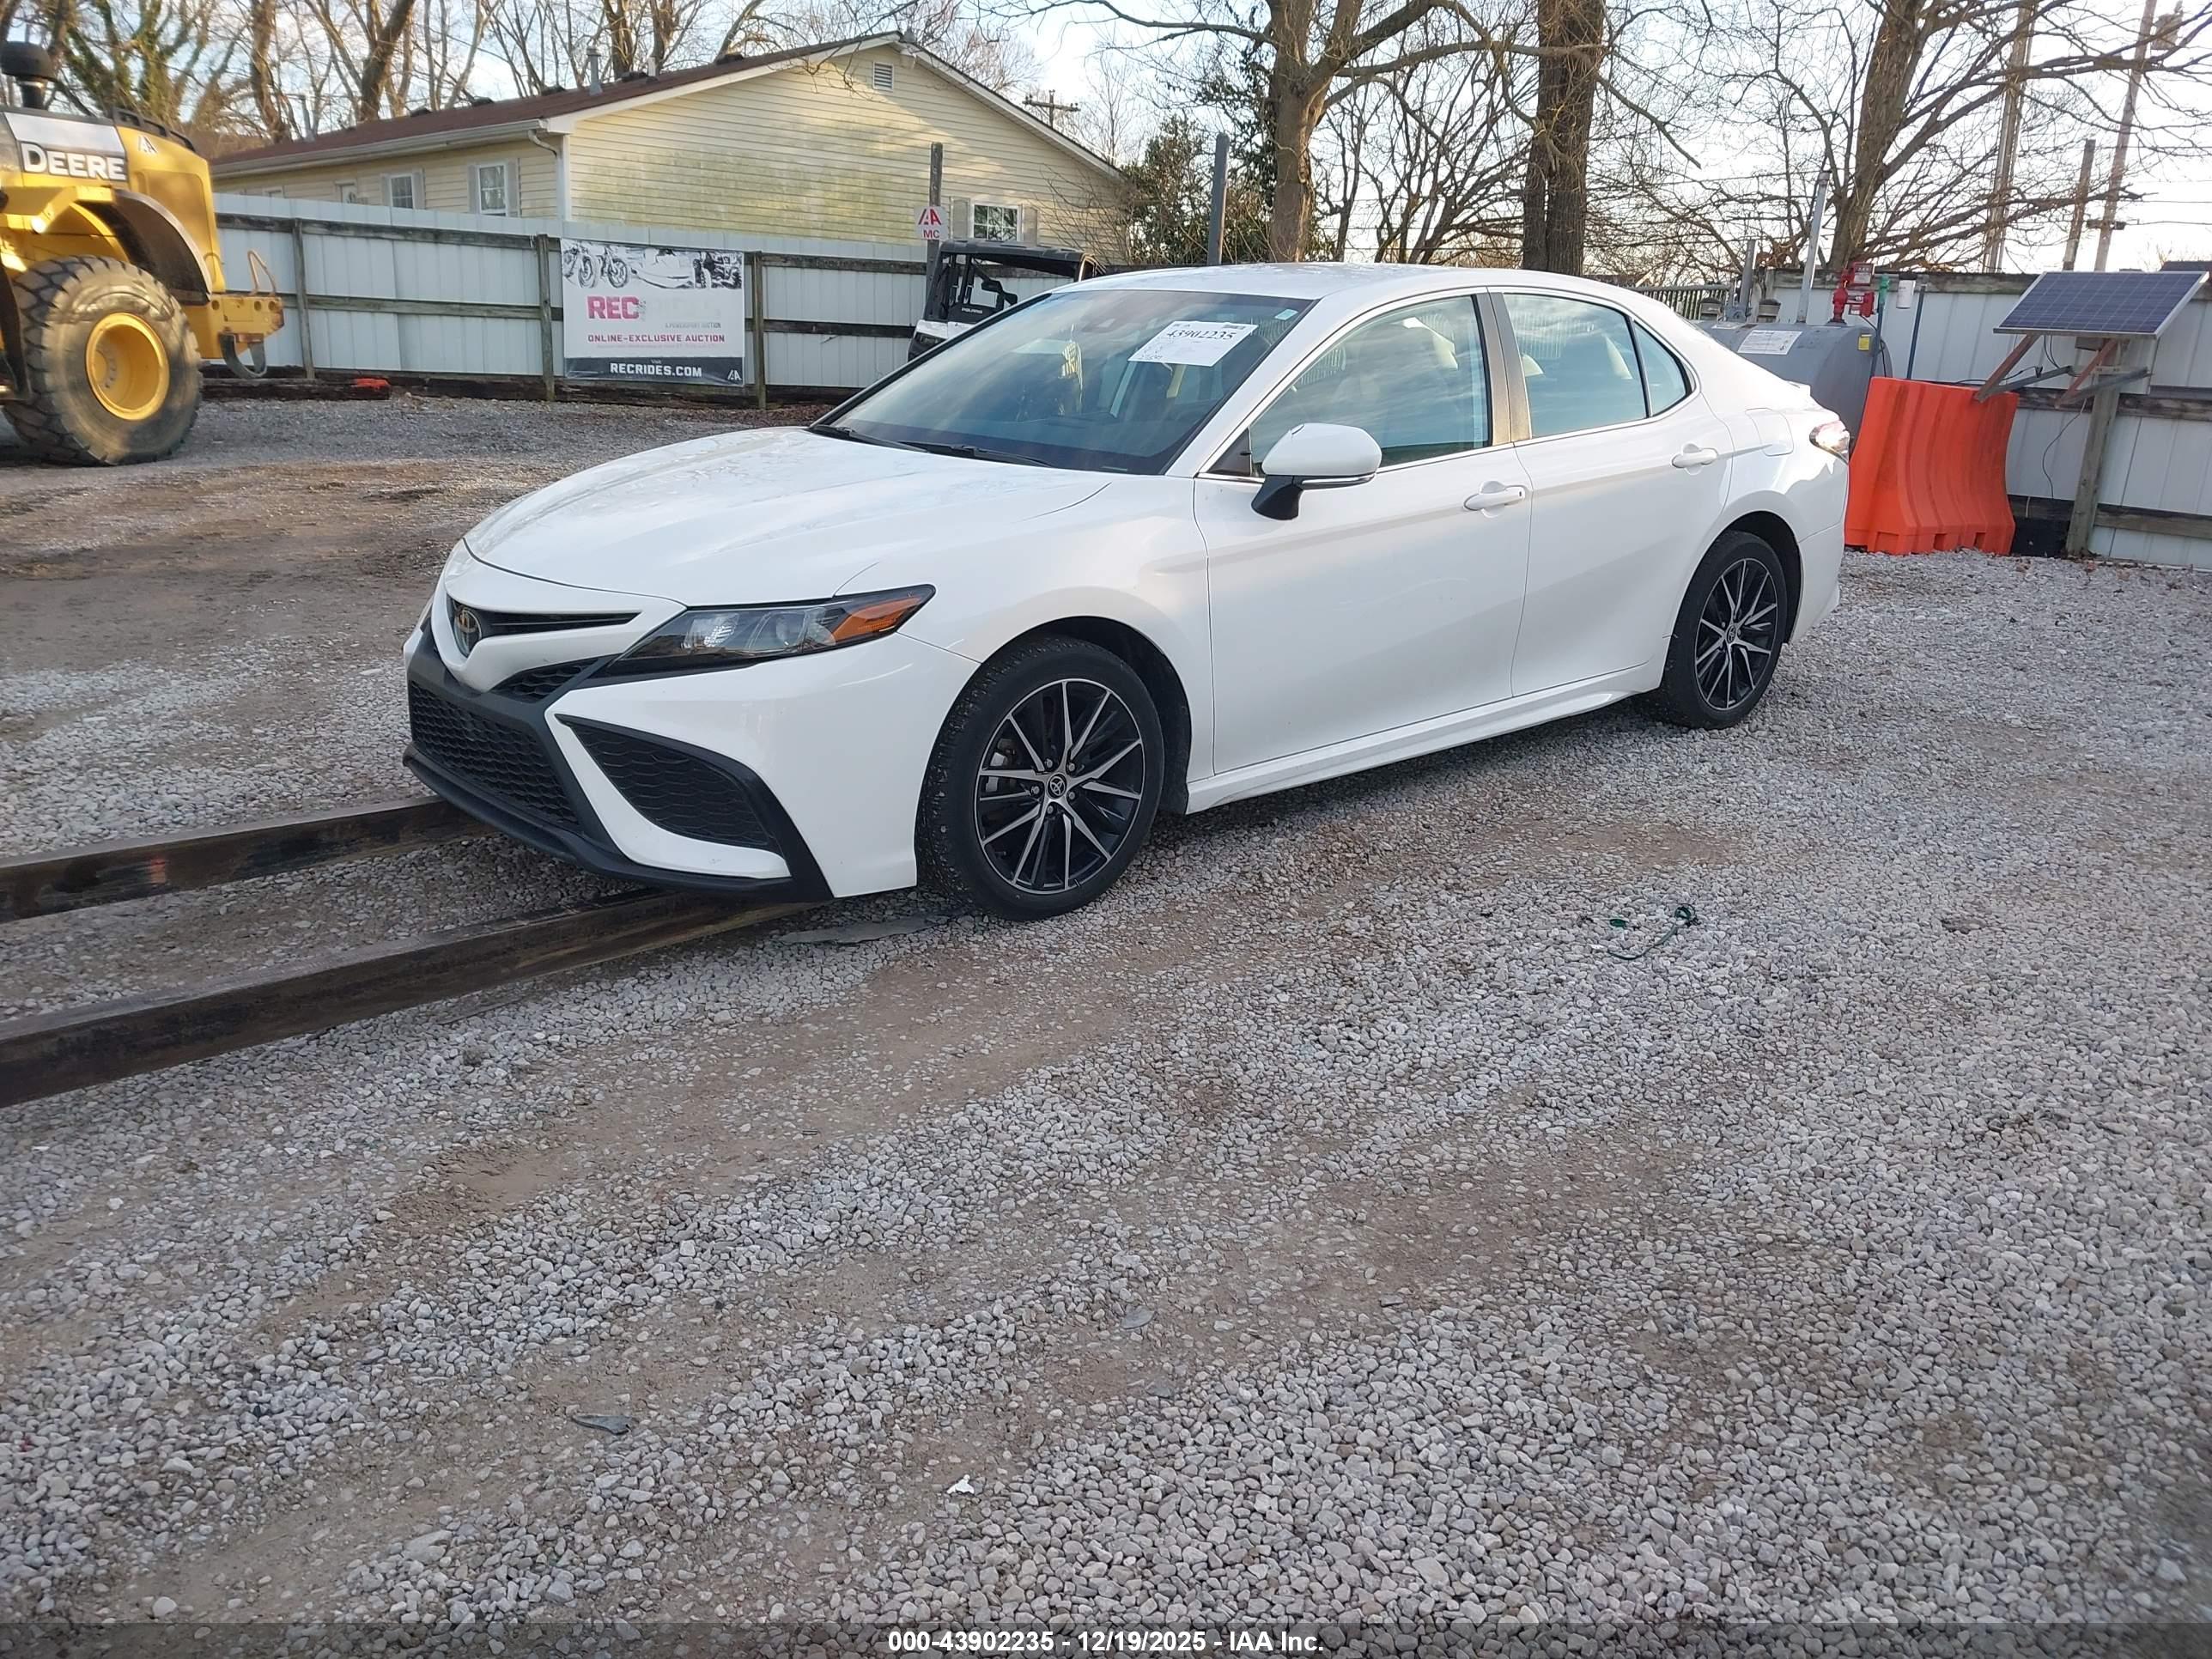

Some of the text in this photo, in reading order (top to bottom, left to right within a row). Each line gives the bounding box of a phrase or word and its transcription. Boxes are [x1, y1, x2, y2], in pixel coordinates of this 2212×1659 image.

[21, 143, 126, 180] DEERE
[923, 229, 940, 239] MC
[587, 296, 640, 319] REC
[587, 334, 725, 343] ONLINE-EXCLUSIVE AUCTION
[1167, 329, 1237, 340] 43902235
[610, 362, 702, 378] RECRIDES.COM
